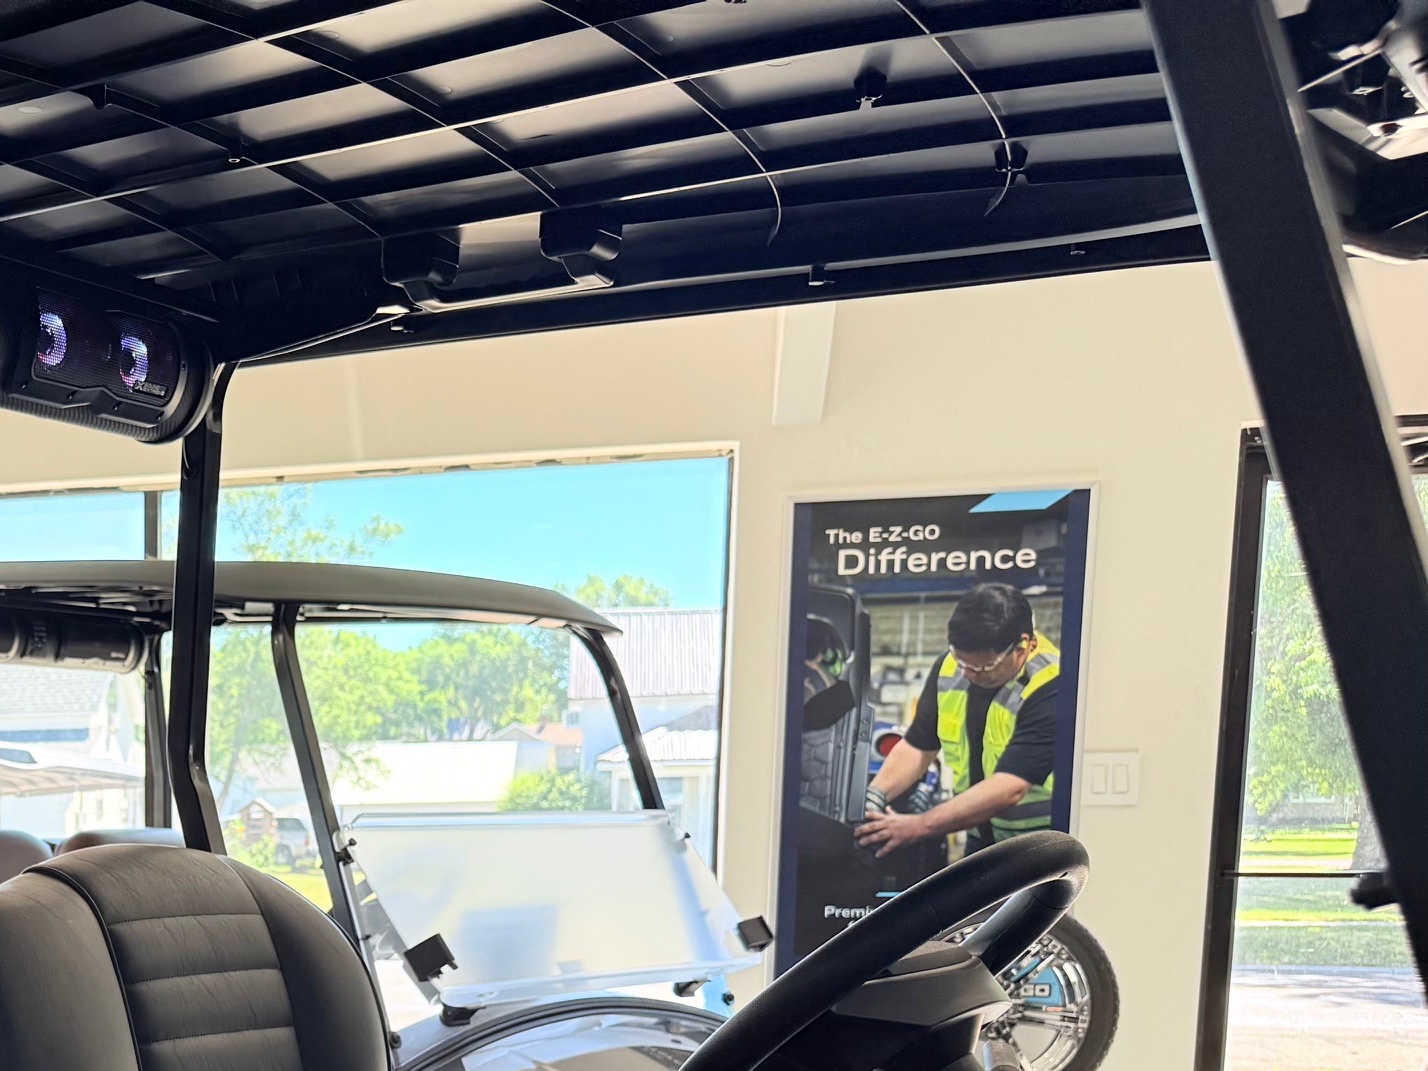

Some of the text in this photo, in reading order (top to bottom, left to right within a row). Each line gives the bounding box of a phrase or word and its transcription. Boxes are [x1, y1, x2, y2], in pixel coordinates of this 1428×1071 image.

[825, 524, 940, 544] The E-Z-GO
[837, 546, 1037, 576] Difference
[824, 905, 874, 918] Premi
